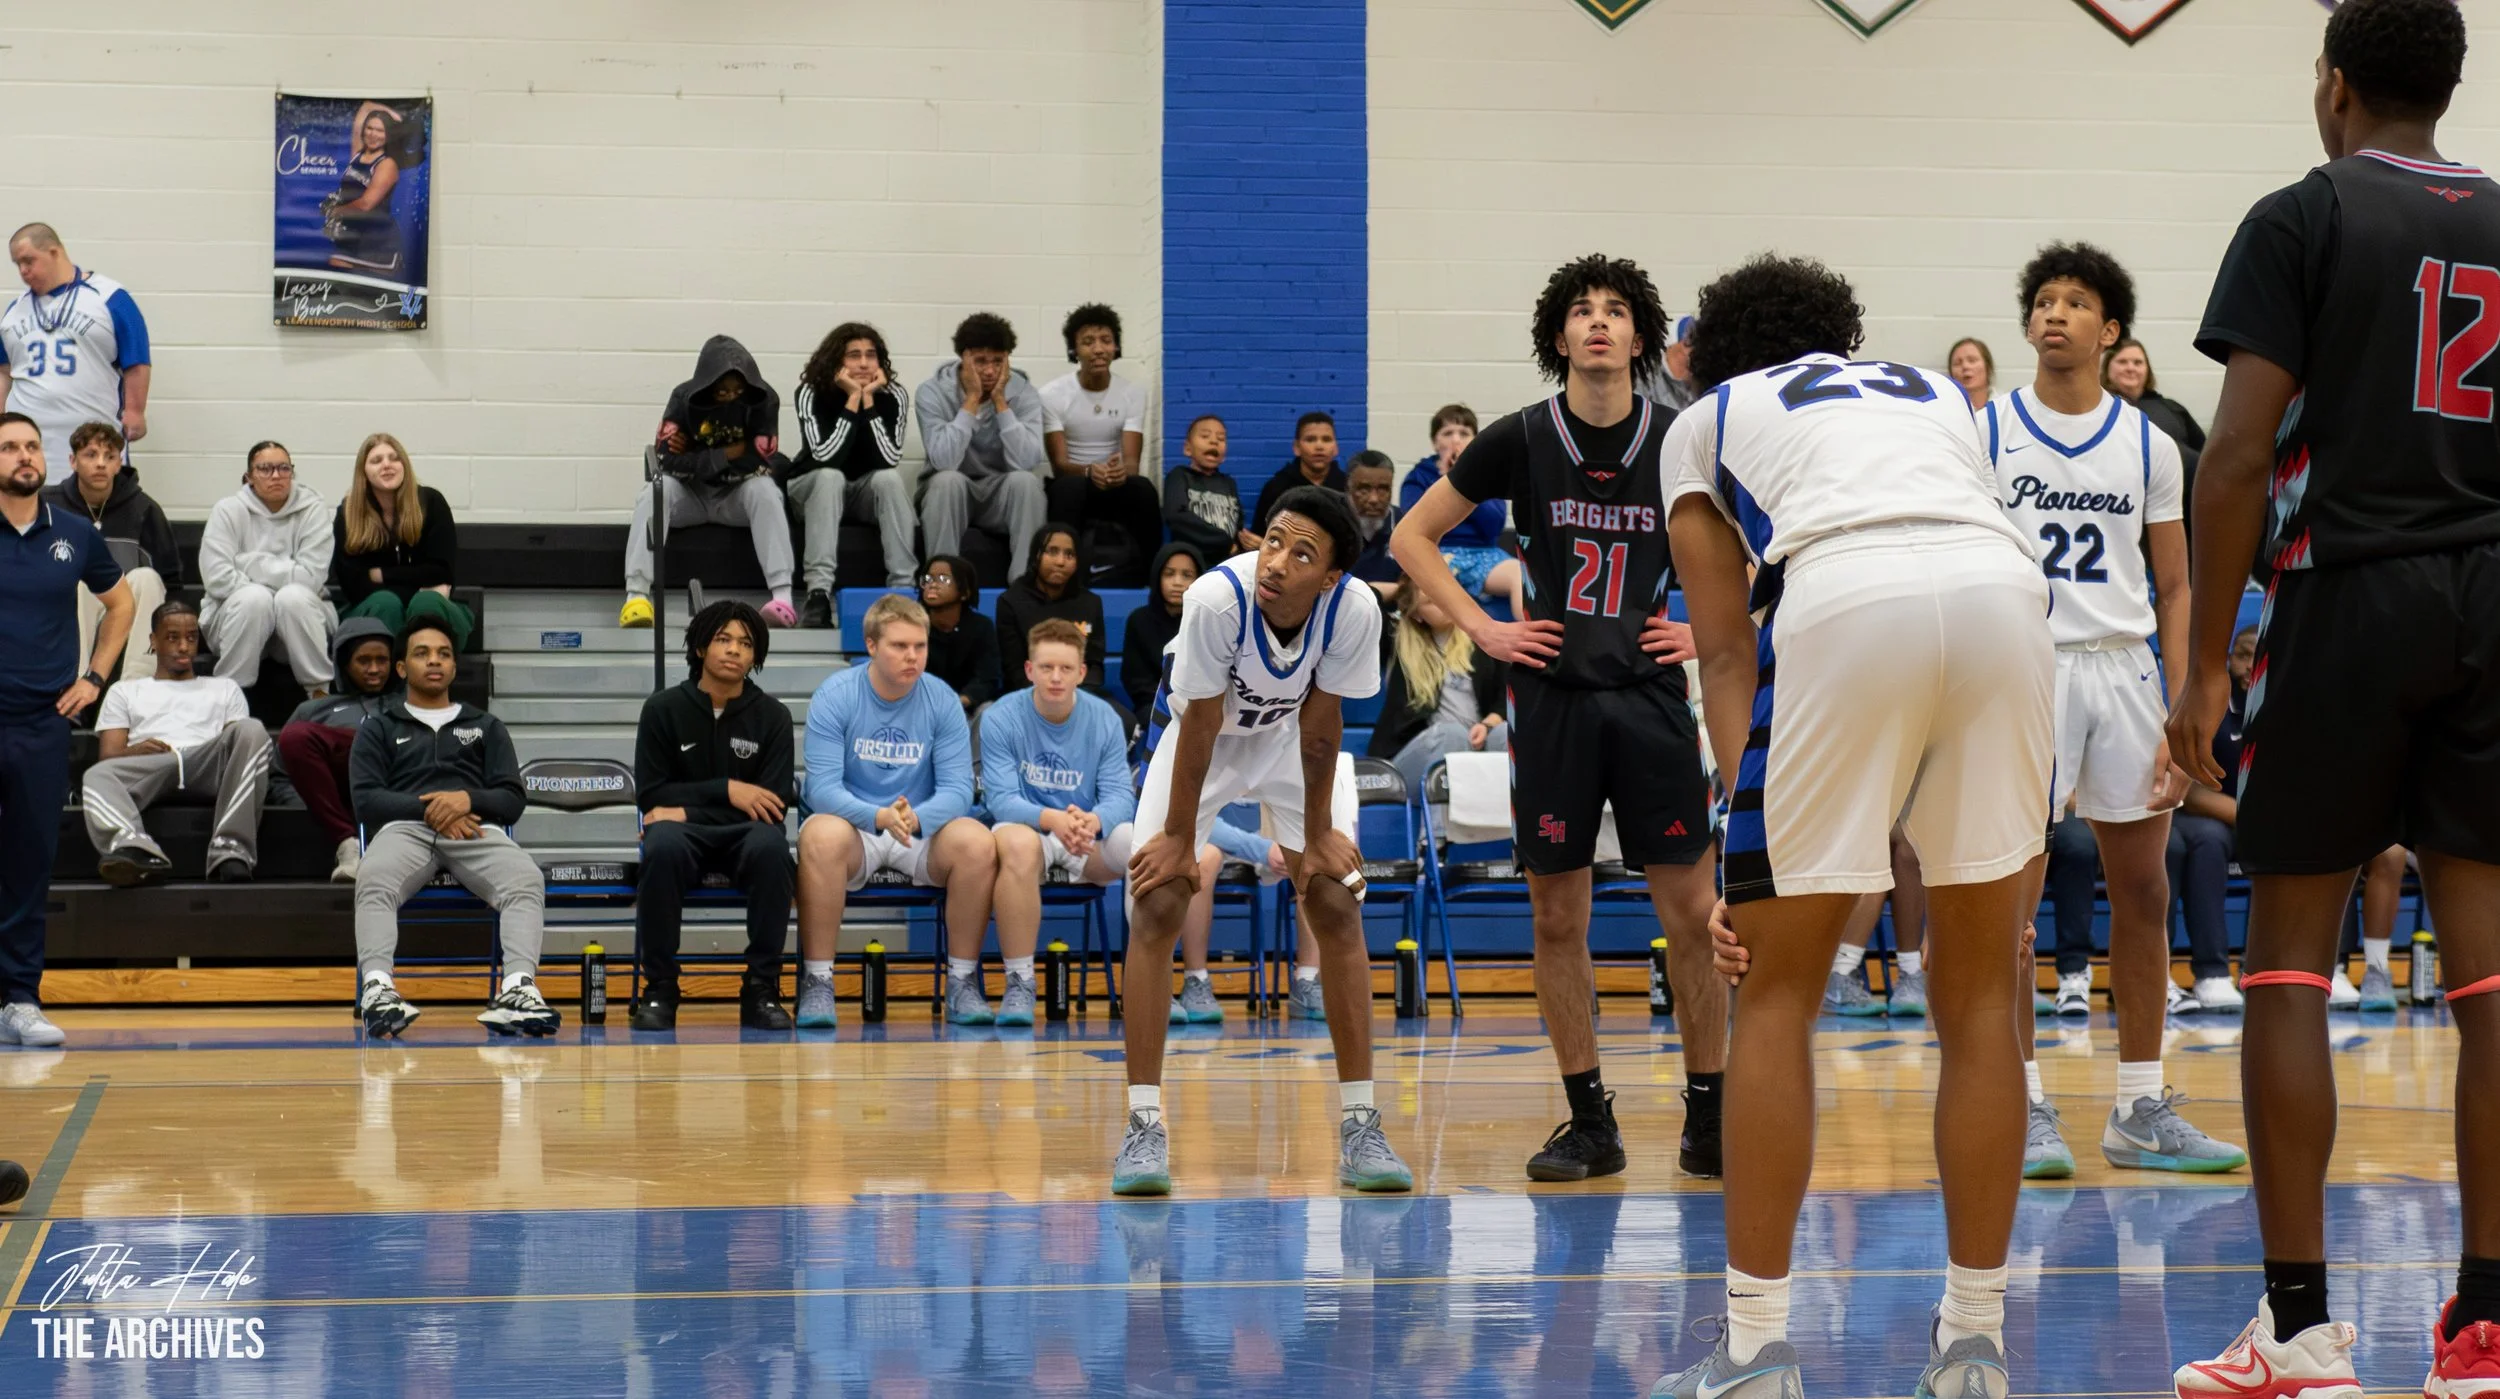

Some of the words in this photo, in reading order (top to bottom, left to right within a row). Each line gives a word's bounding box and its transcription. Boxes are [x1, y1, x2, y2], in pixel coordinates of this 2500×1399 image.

[276, 134, 337, 175] Cheer
[282, 275, 332, 302] Lacey
[285, 316, 355, 328] LEAVENWORTH
[382, 320, 417, 330] SCHOOL
[293, 296, 336, 321] Bone
[2412, 255, 2500, 423] 12
[27, 338, 77, 377] 35
[1764, 360, 1938, 412] 23
[2007, 475, 2135, 515] Pioneers
[1550, 499, 1656, 532] HEIGHTS
[2039, 522, 2108, 583] 22
[1566, 537, 1629, 618] 21
[1237, 707, 1297, 729] 10
[854, 737, 895, 758] FIRST
[895, 742, 925, 760] CITY
[526, 775, 625, 792] PIONEERS
[1053, 769, 1084, 786] CITY
[1538, 814, 1566, 843] SH
[551, 866, 587, 881] EST.
